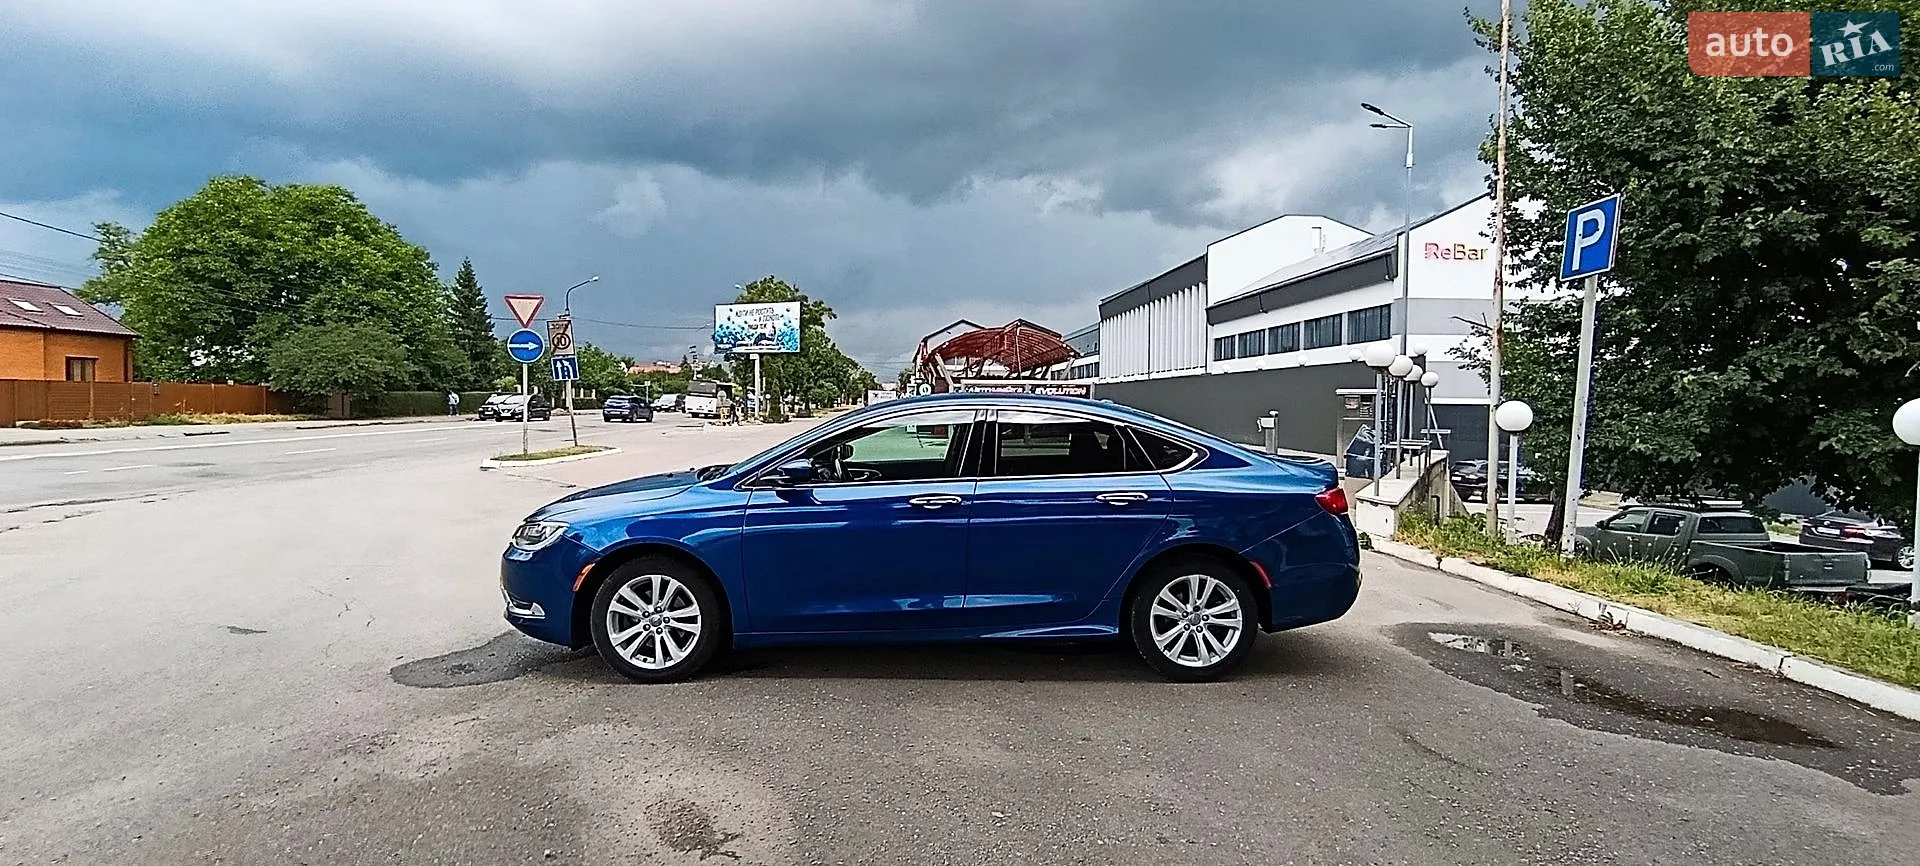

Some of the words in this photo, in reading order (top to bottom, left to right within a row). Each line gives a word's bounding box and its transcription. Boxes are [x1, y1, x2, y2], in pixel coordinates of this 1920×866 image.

[1572, 209, 1605, 271] P
[1424, 242, 1489, 261] ReBar
[1035, 386, 1087, 395] EVOLUTION
